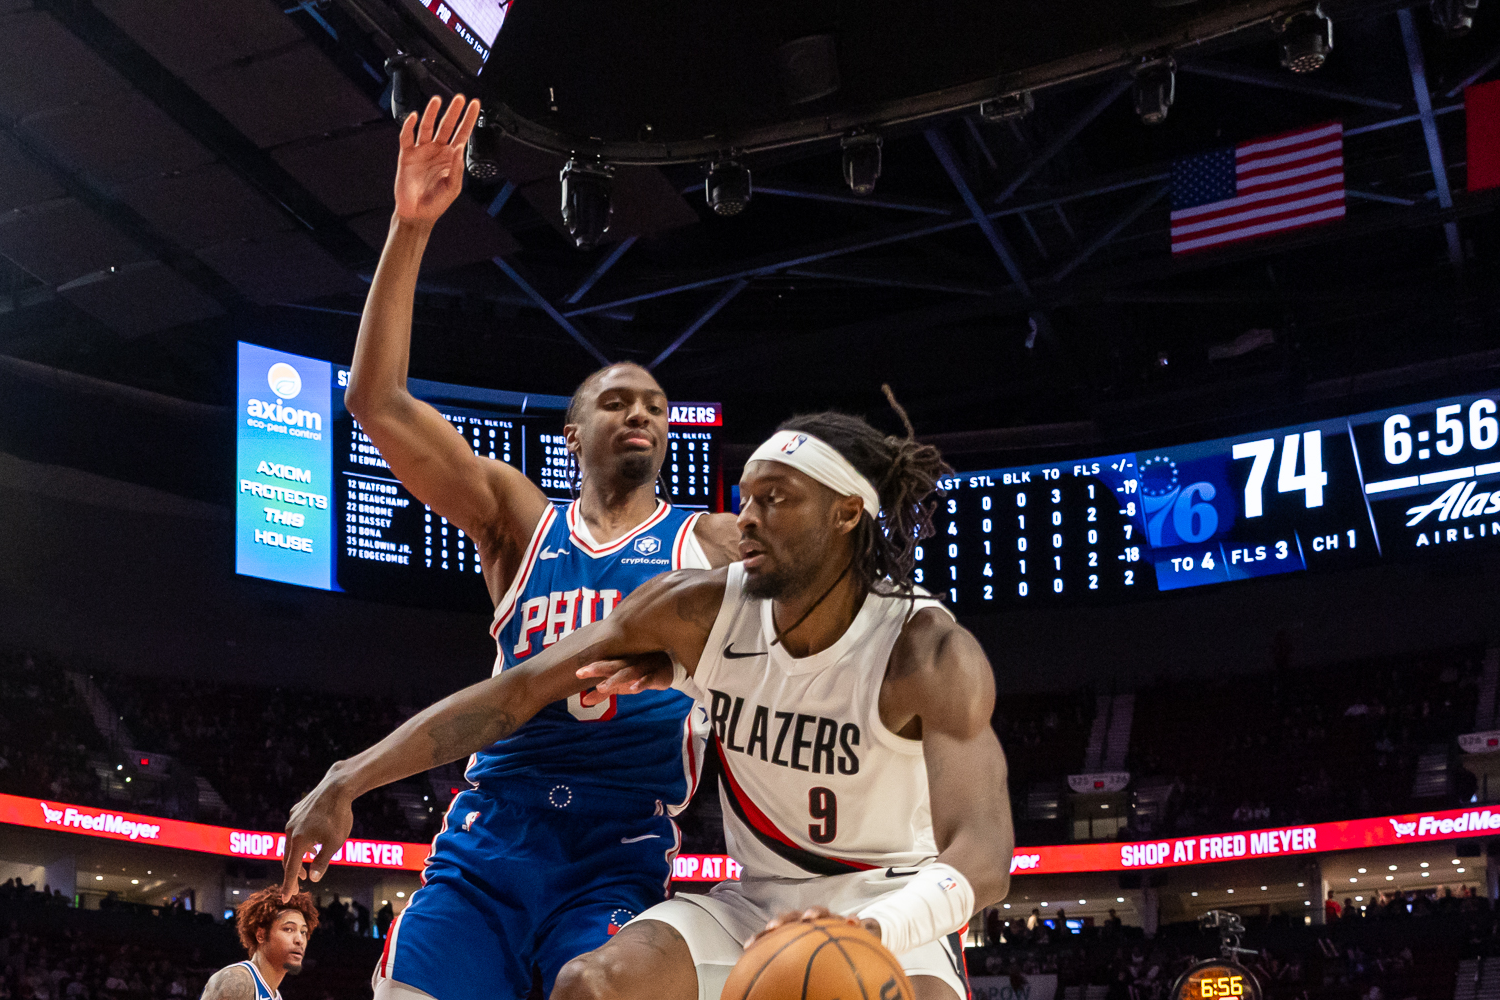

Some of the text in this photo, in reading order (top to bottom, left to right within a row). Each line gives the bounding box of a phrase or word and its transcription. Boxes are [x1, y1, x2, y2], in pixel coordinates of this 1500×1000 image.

[247, 398, 322, 431] axiom
[247, 418, 322, 441] eco-pest control
[351, 431, 357, 440] 7
[473, 439, 480, 448] 0
[489, 440, 495, 449] 1
[503, 442, 511, 451] 2
[473, 427, 480, 437] 0
[489, 429, 496, 438] 0
[504, 431, 509, 440] 1
[1383, 398, 1499, 465] 6:56
[349, 453, 357, 463] 11
[351, 442, 357, 451] 9
[503, 453, 511, 462] 0
[256, 460, 311, 484] AXIOM
[541, 467, 552, 477] 23
[541, 478, 552, 488] 33
[969, 475, 995, 488] STL
[1003, 471, 1031, 485] BLK
[1042, 468, 1060, 480] TO
[1073, 463, 1100, 477] FLS
[1232, 430, 1327, 518] 74
[240, 479, 328, 509] PROTECTS
[348, 479, 398, 495] 12 WATFORD
[947, 479, 1138, 514] 3 0 0 3 1 -19
[346, 502, 393, 518] 22 BROOME
[348, 491, 410, 508] 16 BEAUCHAMP
[1405, 481, 1500, 527] Alas
[264, 507, 305, 528] THIS
[346, 513, 392, 528] 28 BASSEY
[947, 502, 1136, 536] 4 0 1 0 2 -8
[254, 529, 313, 553] HOUSE
[346, 525, 382, 538] 30 BONA
[914, 525, 1133, 561] 0 0 1 0 0 0 7
[1416, 521, 1500, 547] AIRLIN
[346, 536, 357, 546] 35
[358, 537, 396, 552] BALDWIN
[1171, 530, 1356, 572] TO 4 FLS 3 CH 1
[347, 548, 410, 565] 77 EDGECOMBE
[621, 557, 670, 566] crypto.com
[914, 547, 1140, 583] 3 1 4 1 1 2 -18
[950, 570, 1134, 603] 1 2 0 0 2 2
[707, 688, 860, 776] BLAZERS
[808, 786, 837, 844] 9
[1418, 810, 1500, 836] FredMe
[229, 831, 274, 857] SHOP
[345, 841, 404, 866] MEYER
[1120, 827, 1317, 867] SHOP AT FRED MEYER
[701, 857, 723, 878] AT
[1201, 976, 1243, 998] 6:56
